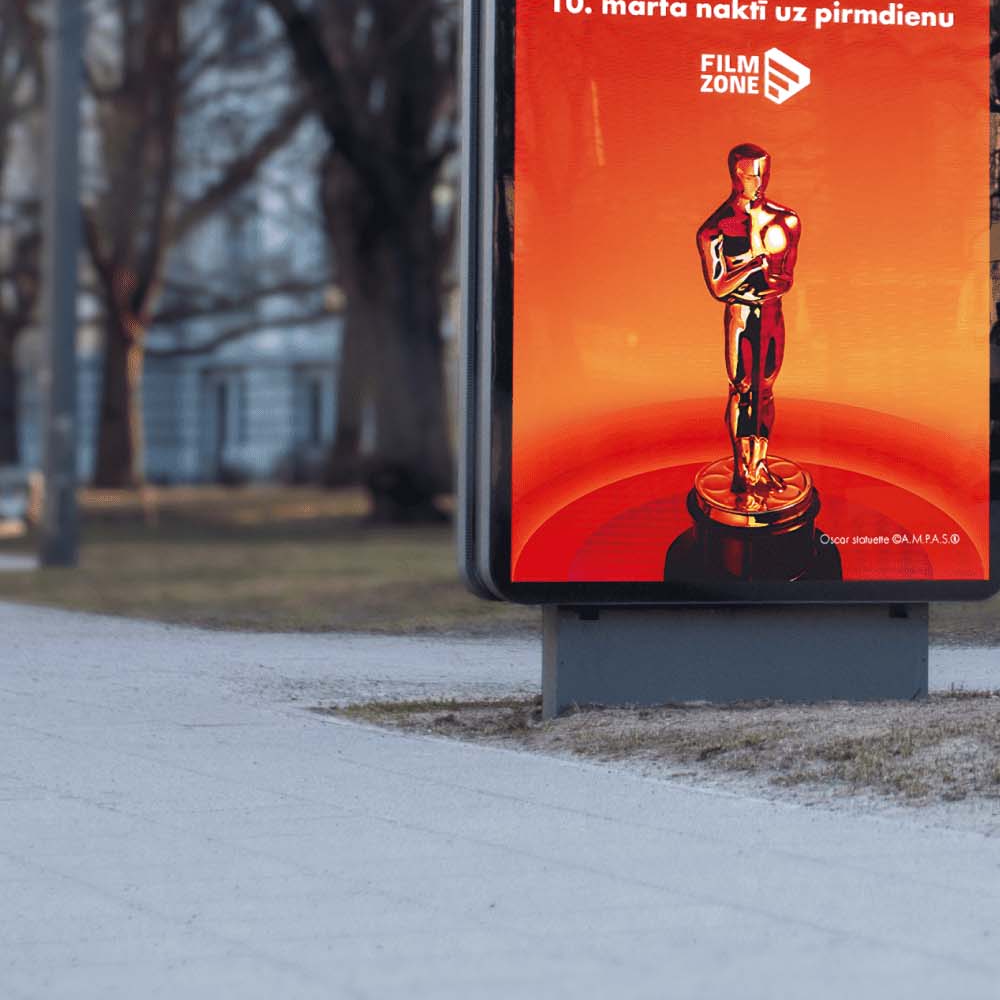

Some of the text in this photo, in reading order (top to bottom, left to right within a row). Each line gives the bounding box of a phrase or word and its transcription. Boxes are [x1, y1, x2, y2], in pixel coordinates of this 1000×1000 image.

[775, 6, 806, 24] uz
[815, 1, 955, 29] pirmdienu
[701, 54, 760, 74] FILM
[700, 74, 760, 95] ZONE
[820, 534, 849, 545] Oscar
[852, 535, 889, 545] statuette
